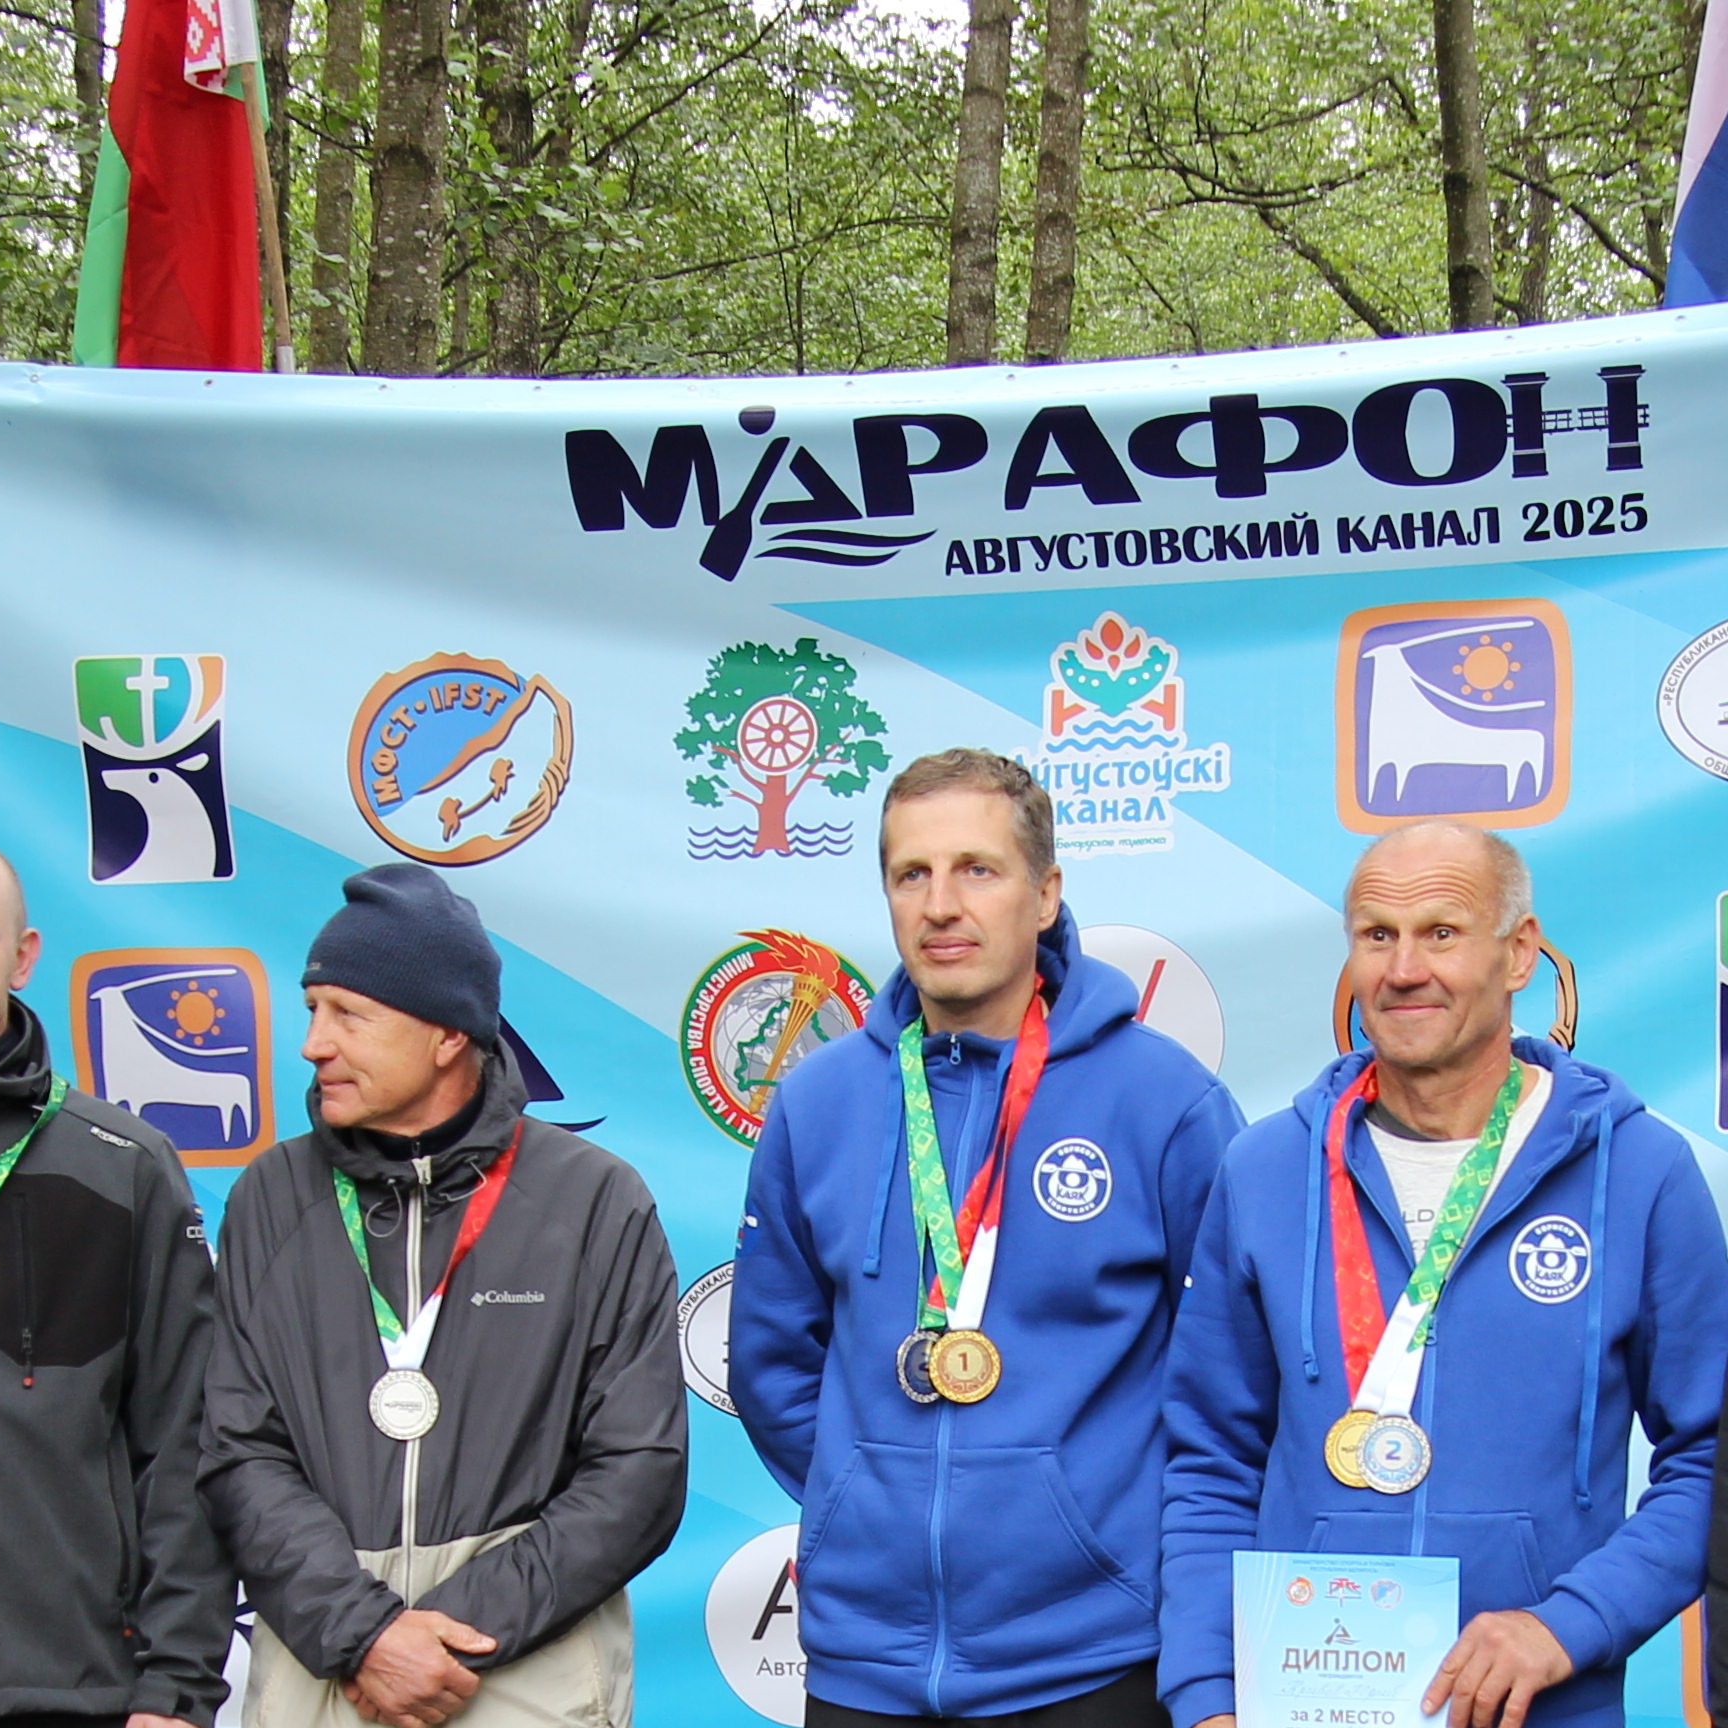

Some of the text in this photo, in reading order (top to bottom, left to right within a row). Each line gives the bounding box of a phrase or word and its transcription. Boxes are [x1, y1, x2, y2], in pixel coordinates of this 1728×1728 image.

[565, 364, 1650, 582] МАРАФОН
[945, 492, 1649, 576] АВГУСТОВСКИЙ КАНАЛ 2025
[1056, 795, 1167, 826] канал
[689, 1056, 730, 1115] СПОРТУ
[485, 1290, 545, 1305] Columbia
[957, 1351, 969, 1373] 1
[1385, 1440, 1402, 1461] 2
[1282, 1648, 1406, 1673] ДИПЛОМ
[1290, 1709, 1396, 1725] за 2 МЕСТО
